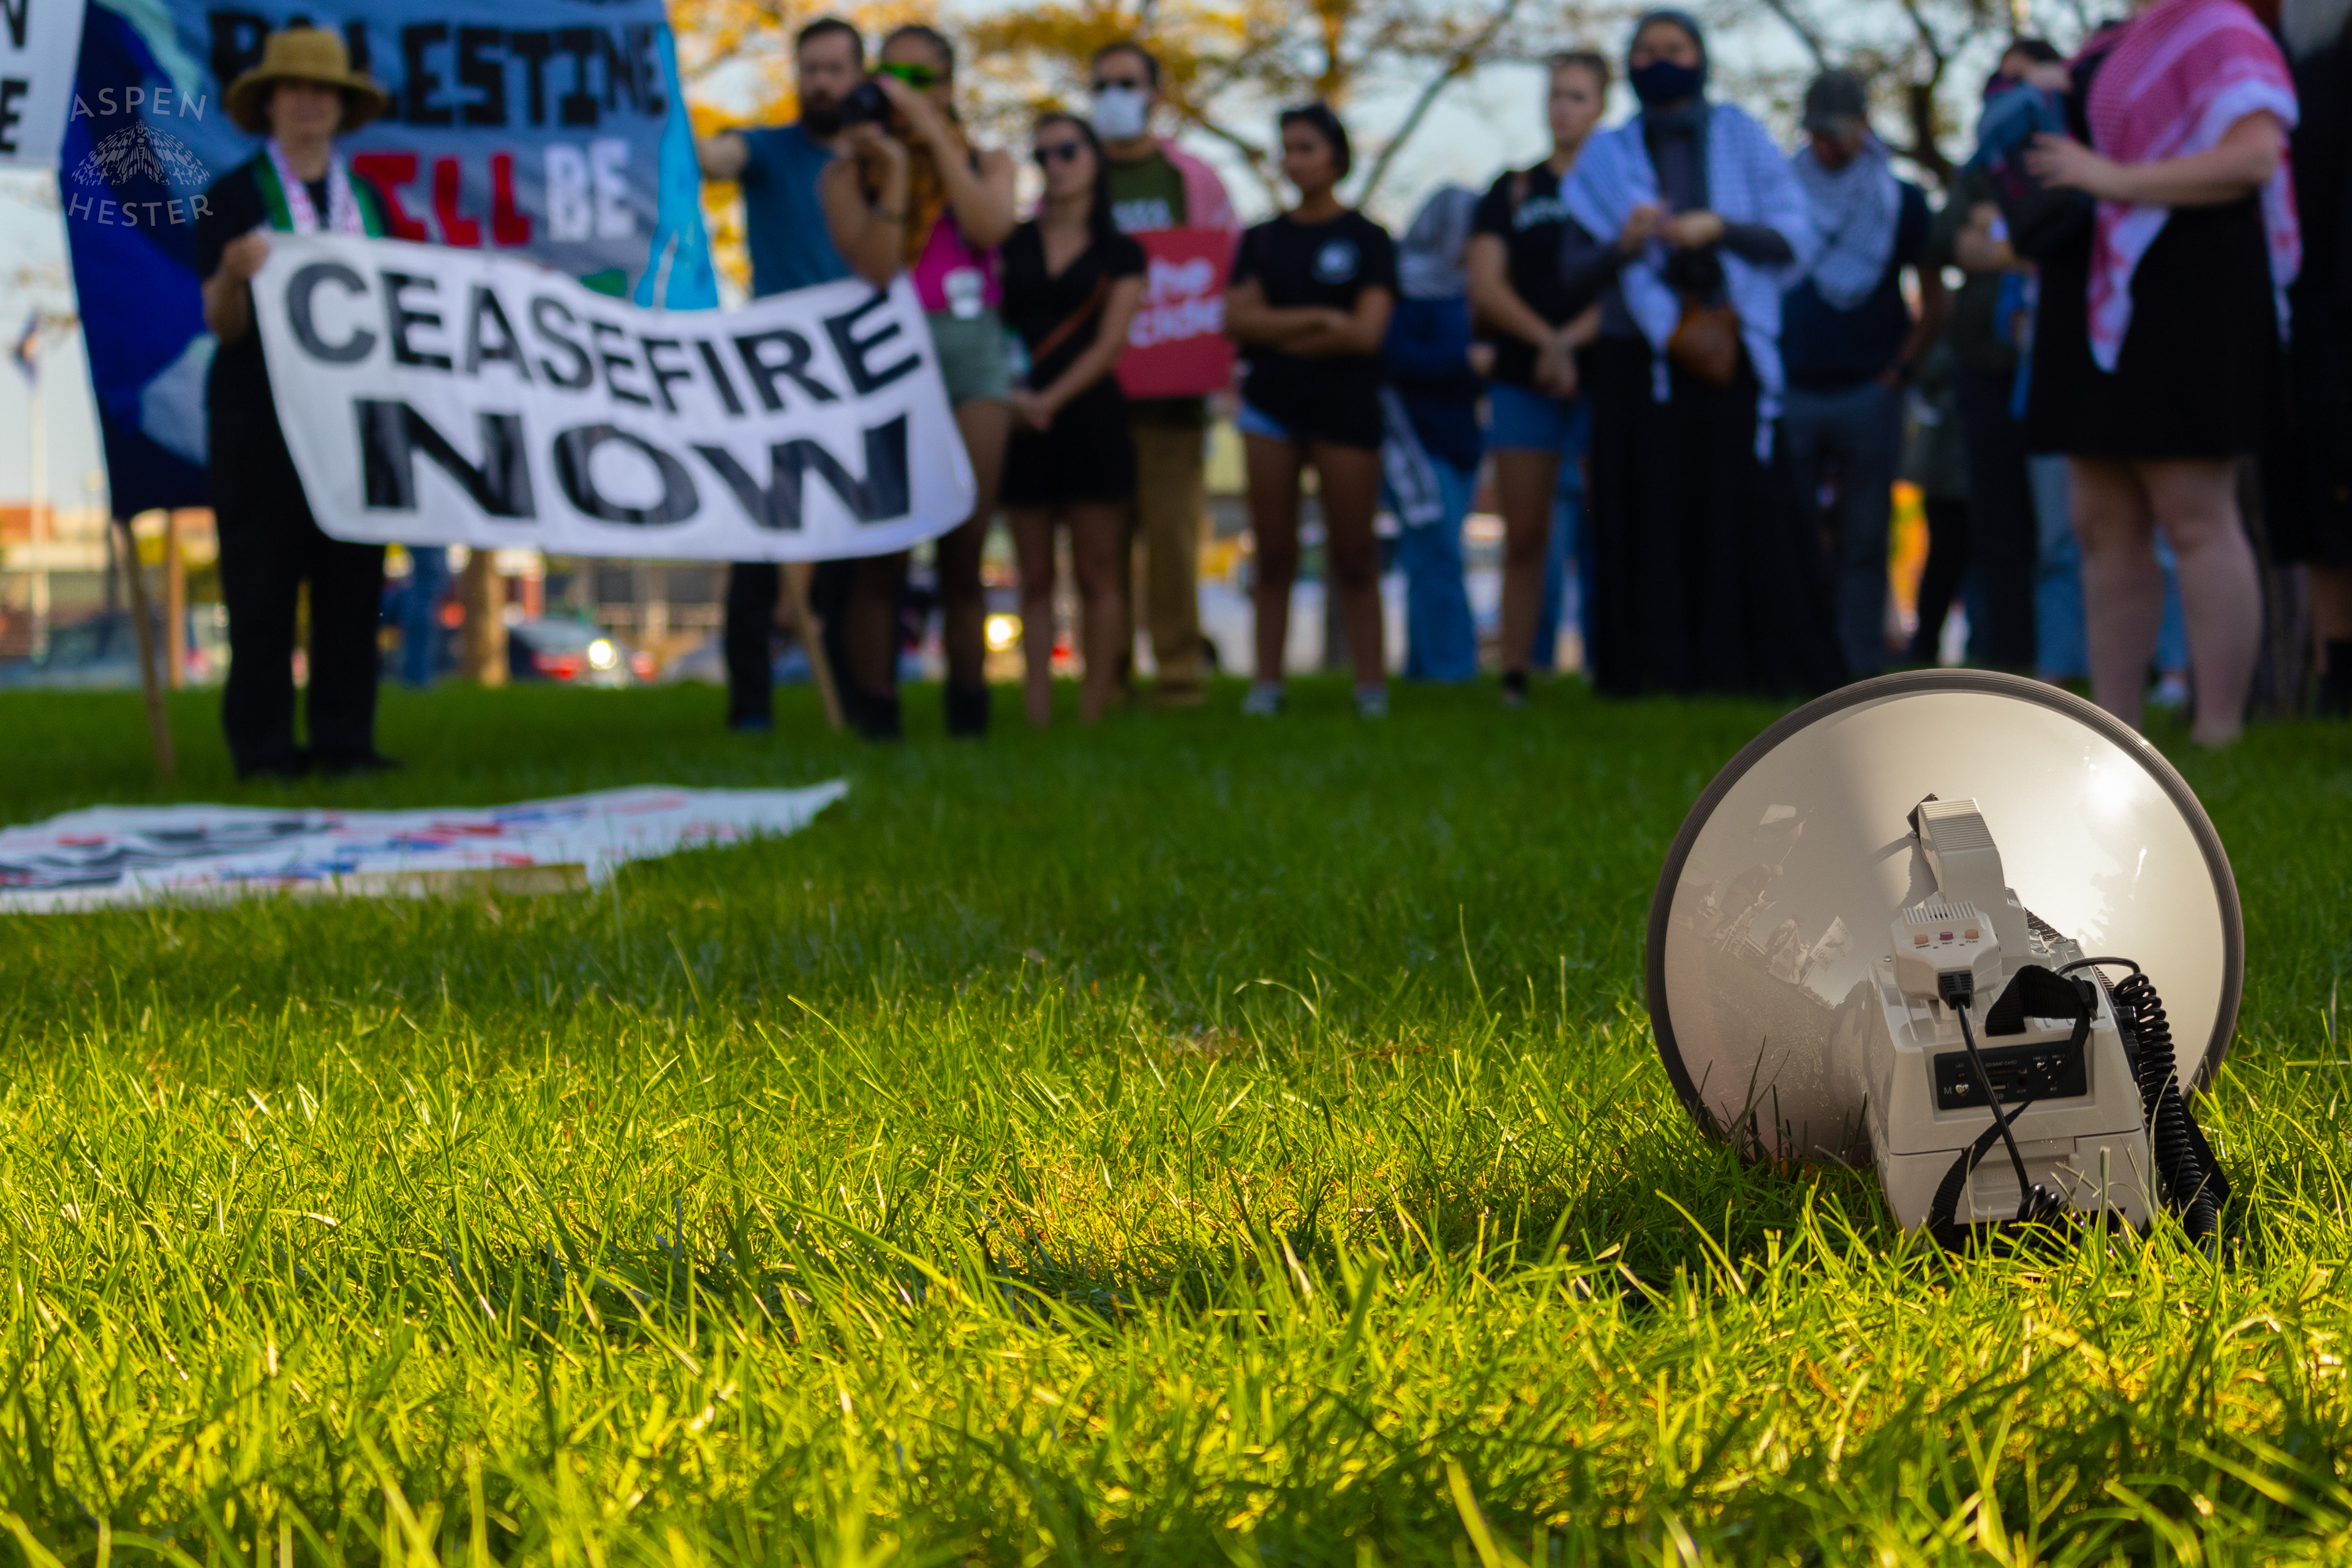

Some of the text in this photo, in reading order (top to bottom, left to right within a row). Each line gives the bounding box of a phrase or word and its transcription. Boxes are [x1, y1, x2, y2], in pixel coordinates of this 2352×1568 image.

[208, 13, 665, 126] PLESTINE
[352, 136, 636, 247] ILL BE
[285, 262, 923, 417] CEASEFIRE
[352, 398, 912, 531] NOW
